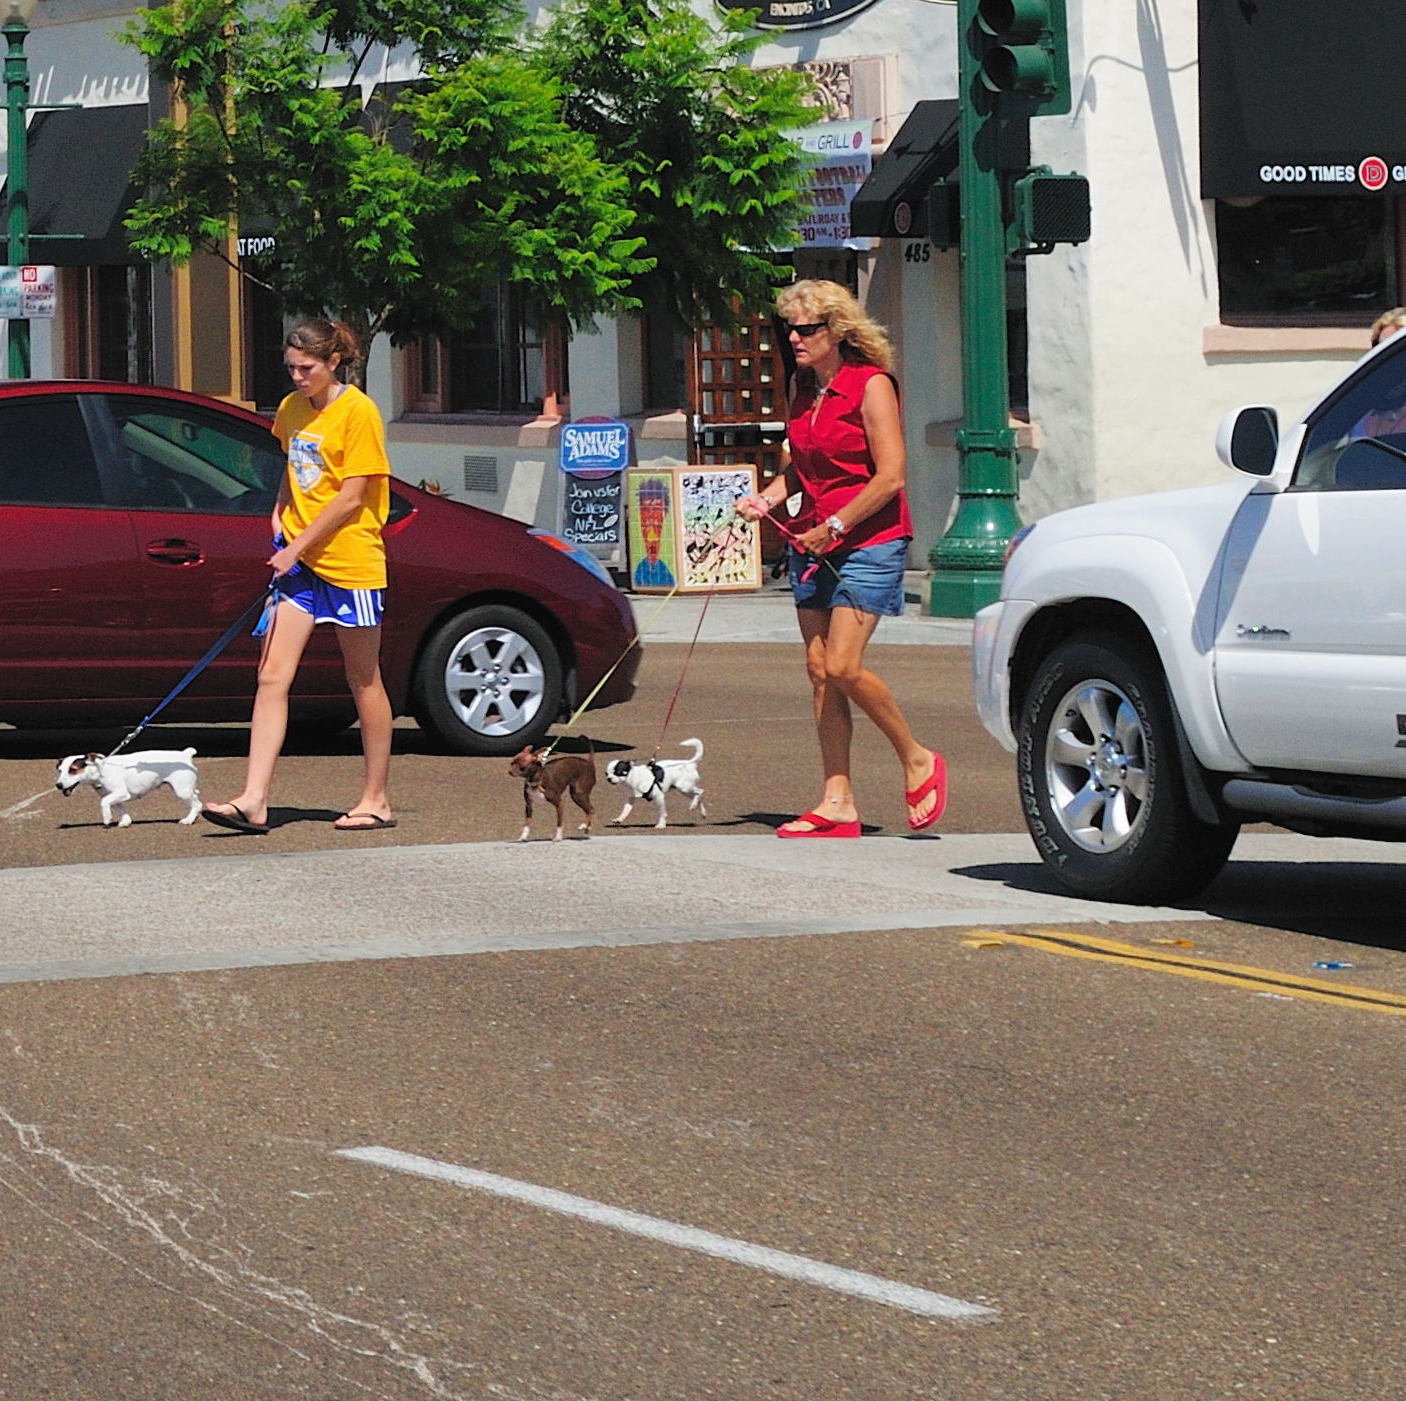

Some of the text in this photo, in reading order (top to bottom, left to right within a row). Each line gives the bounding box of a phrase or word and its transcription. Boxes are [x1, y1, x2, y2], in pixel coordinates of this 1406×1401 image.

[817, 134, 850, 150] GRILL
[1259, 165, 1356, 182] GOOD TIMES
[1392, 165, 1406, 182] G
[904, 243, 931, 263] 485
[23, 269, 36, 281] NO
[24, 283, 54, 293] PARKING
[564, 429, 626, 447] SAMUEL
[568, 443, 621, 463] ADAMS
[570, 499, 615, 518] College
[575, 518, 605, 532] NFL
[563, 528, 617, 544] Specials
